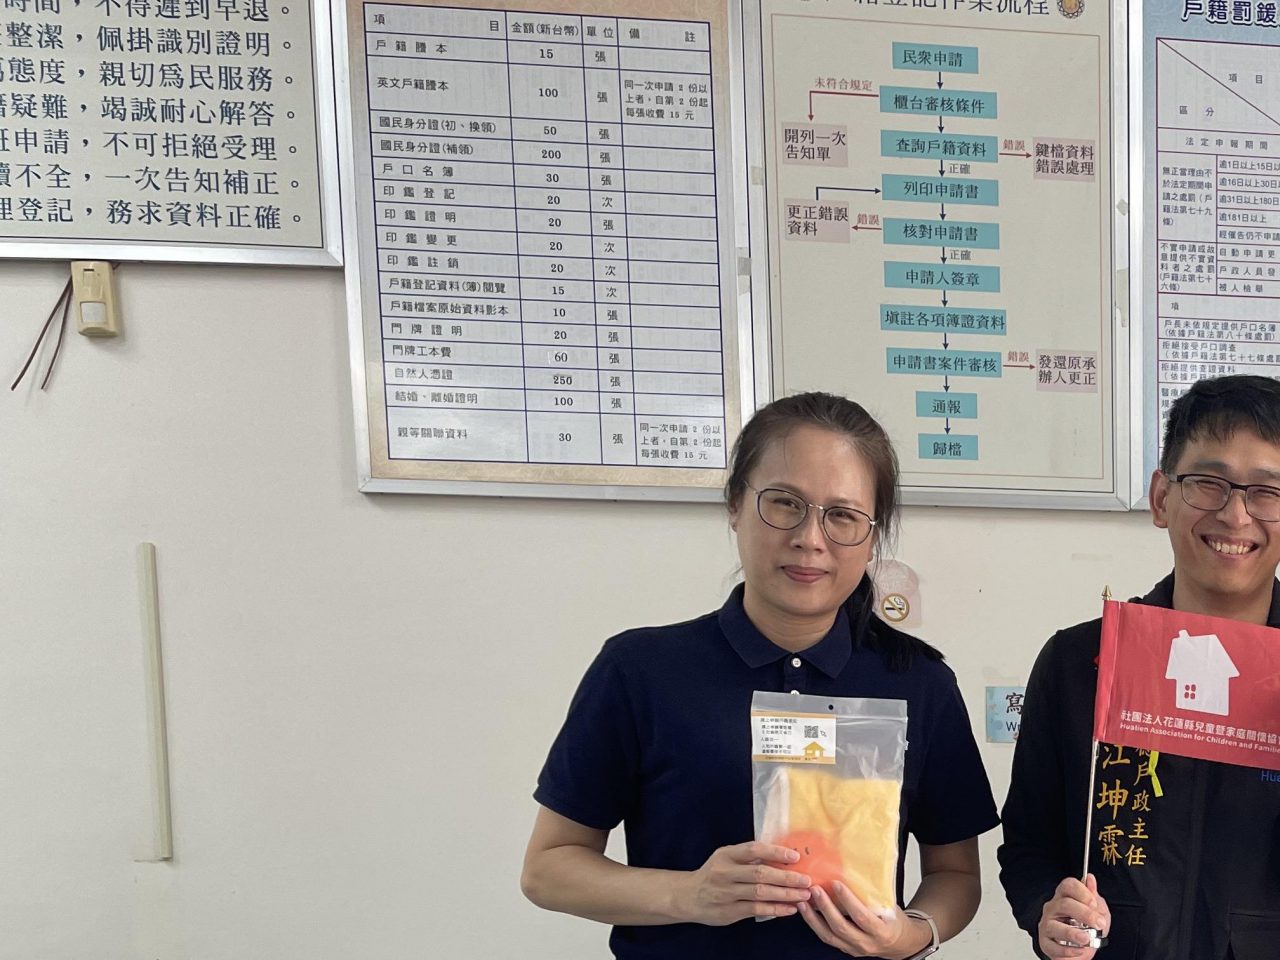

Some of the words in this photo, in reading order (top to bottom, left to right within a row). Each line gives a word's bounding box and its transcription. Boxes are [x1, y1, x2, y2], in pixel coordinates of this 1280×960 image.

[512, 22, 579, 37] 金額(新台幣)
[587, 26, 613, 38] 單位
[0, 22, 291, 56] 整潔，佩掛識別證明。
[539, 48, 553, 58] 15
[595, 51, 606, 62] 張
[0, 57, 293, 92] 態度，親切爲民服務。
[538, 88, 558, 98] 100
[597, 92, 608, 103] 張
[543, 126, 557, 136] 50
[598, 128, 610, 140] 張
[541, 149, 561, 160] 200
[600, 152, 611, 163] 張
[785, 144, 831, 162] 告知單
[546, 173, 559, 183] 30
[601, 175, 612, 186] 張
[903, 181, 979, 200] 列印申請書
[547, 195, 560, 205] 20
[602, 196, 613, 208] 次
[548, 218, 561, 227] 20
[603, 219, 614, 231] 張
[787, 220, 818, 237] 資料
[903, 223, 979, 242] 核對申請書
[550, 241, 563, 251] 20
[604, 242, 615, 253] 次
[551, 264, 564, 273] 20
[605, 265, 616, 276] 次
[552, 286, 565, 295] 15
[606, 287, 617, 298] 次
[553, 308, 566, 317] 10
[607, 310, 618, 321] 張
[554, 331, 567, 340] 20
[608, 331, 619, 343] 張
[554, 352, 568, 362] 60
[609, 353, 620, 364] 張
[892, 354, 997, 373] 申請書案件審核
[553, 375, 573, 386] 250
[610, 376, 621, 388] 張
[554, 397, 573, 406] 100
[611, 398, 622, 409] 張
[931, 398, 961, 415] 通報
[558, 432, 572, 442] 30
[612, 433, 624, 445] 張
[1120, 722, 1148, 733] Hualien
[1150, 727, 1192, 740] Association
[1193, 733, 1205, 741] for
[1206, 735, 1238, 747] Children
[1238, 740, 1252, 749] and
